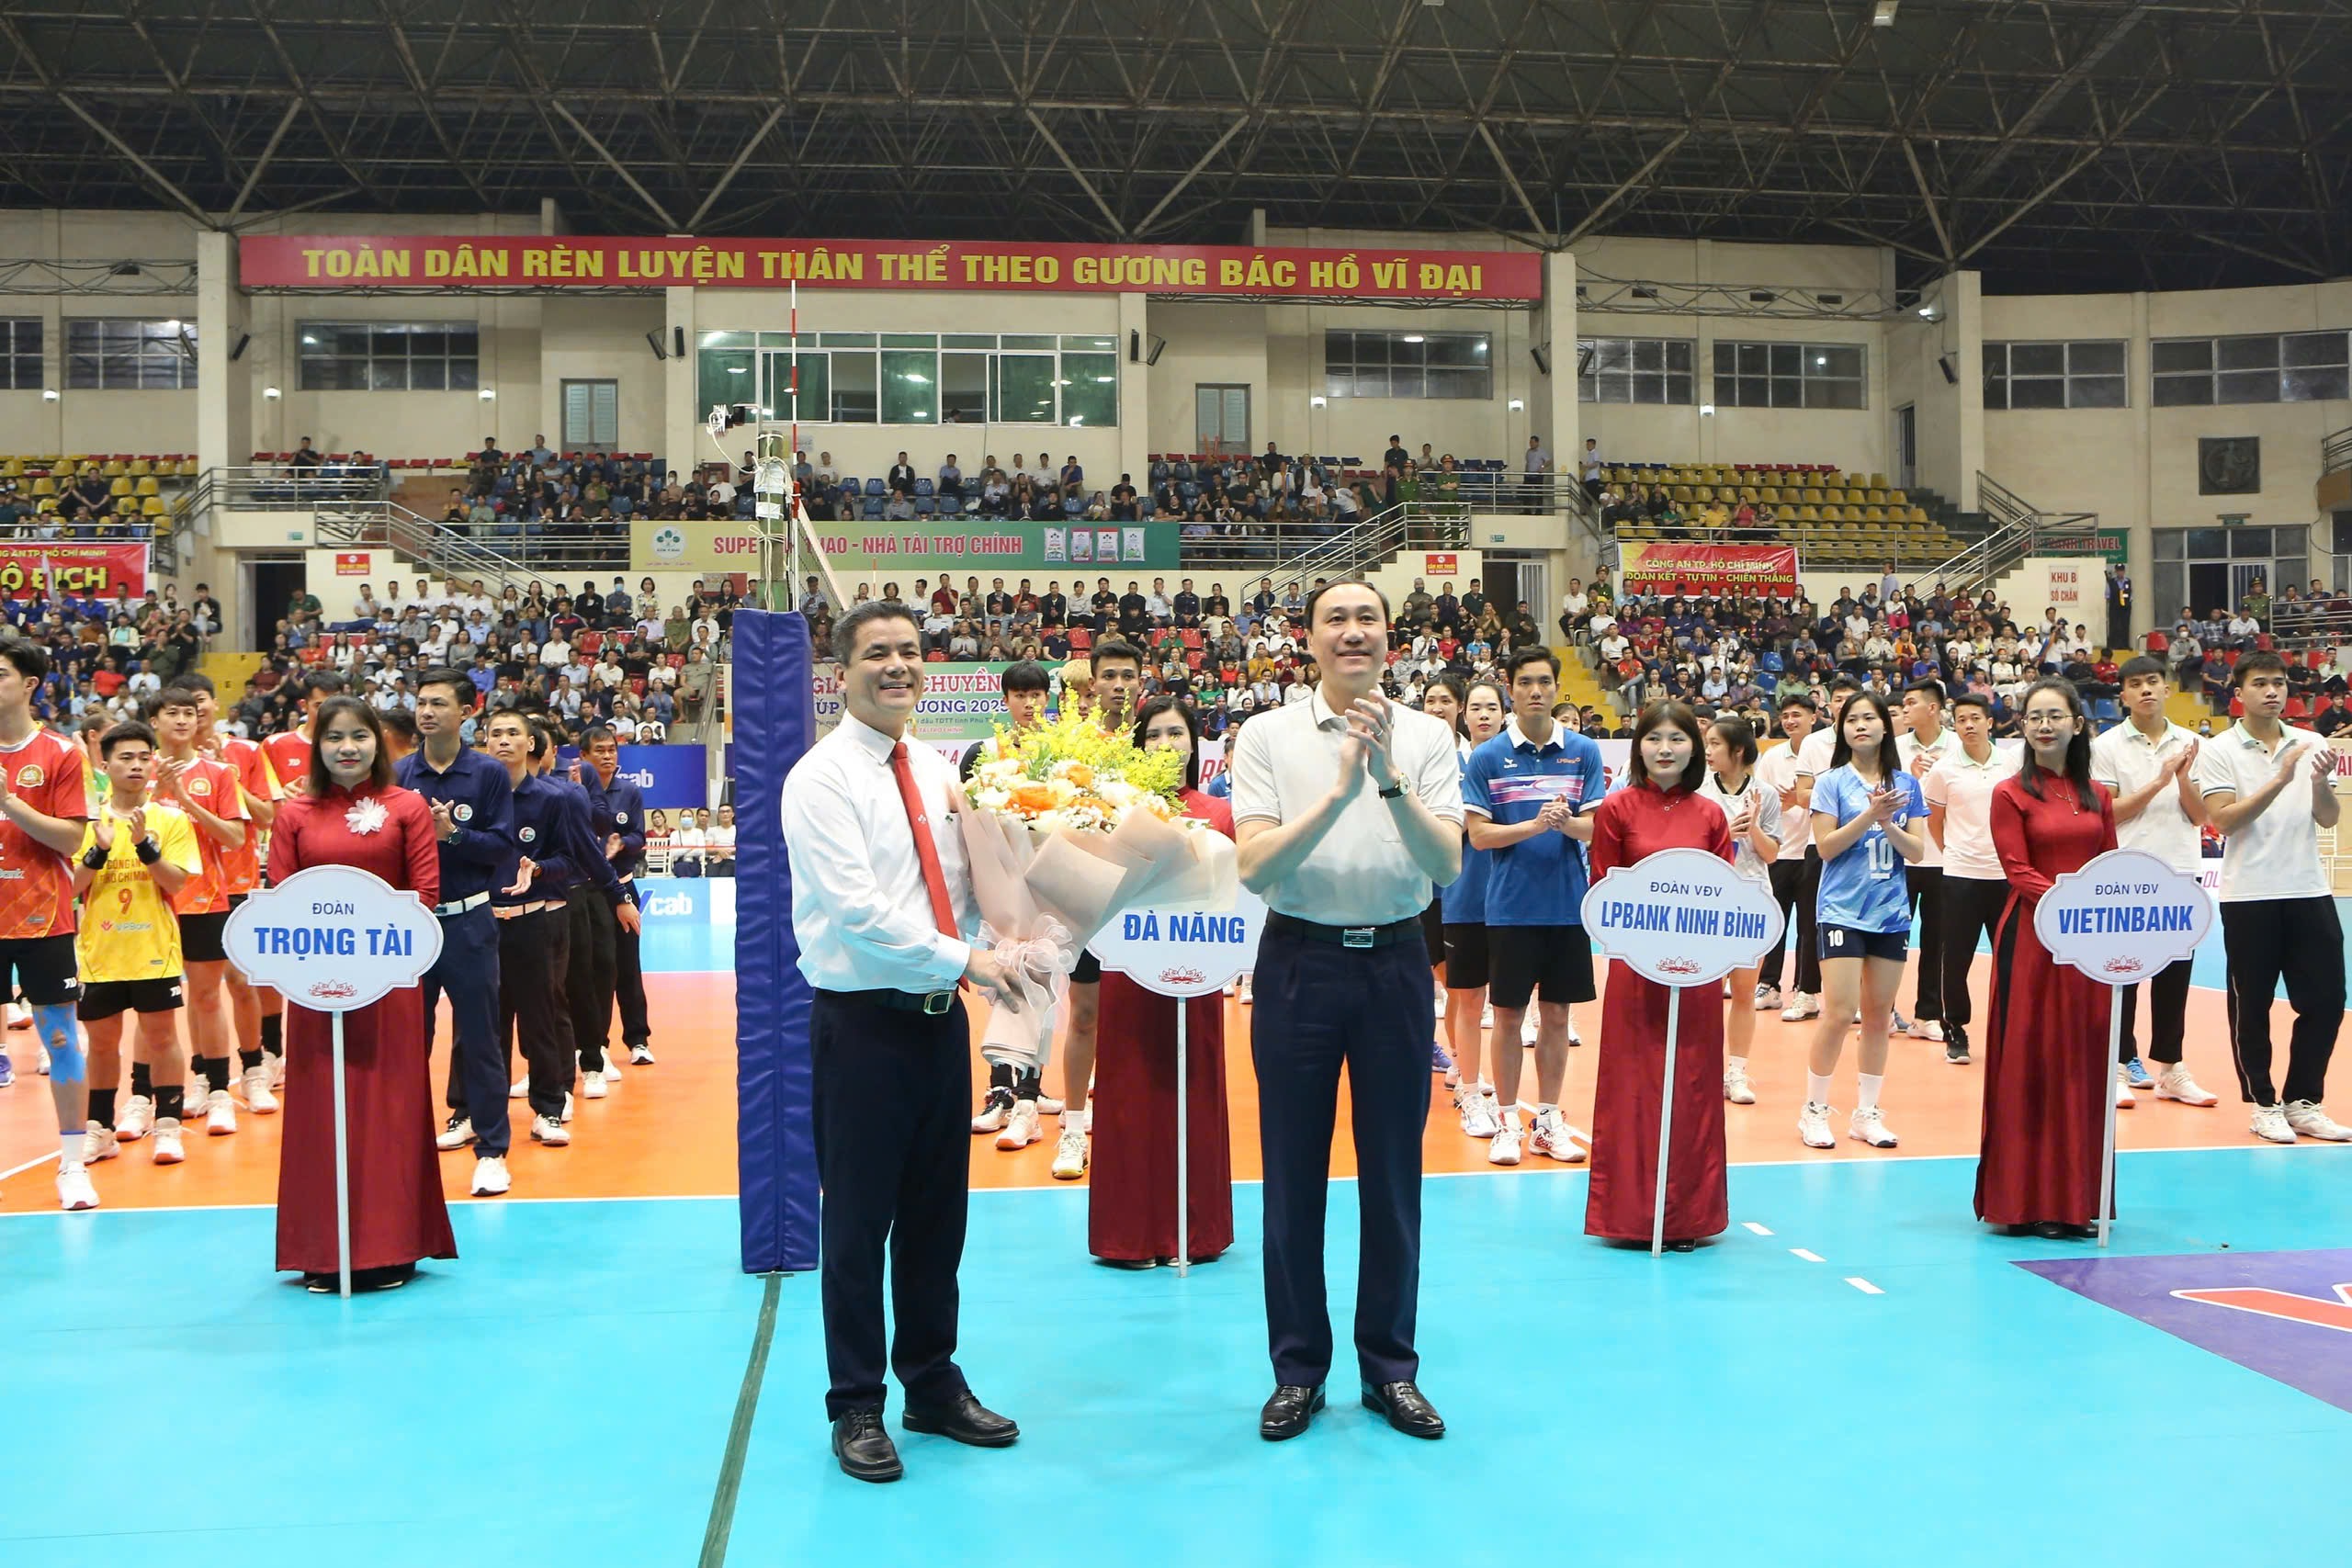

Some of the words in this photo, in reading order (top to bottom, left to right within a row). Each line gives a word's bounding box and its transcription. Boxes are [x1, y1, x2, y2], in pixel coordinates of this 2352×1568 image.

[302, 243, 411, 277] TOÀN
[424, 243, 516, 277] DÂN
[524, 244, 604, 277] RÈN
[617, 245, 745, 284] LUYỆN
[758, 246, 864, 279] THÂN
[876, 244, 950, 281] THỂ
[962, 255, 1059, 283] THEO
[1072, 254, 1207, 286] GƯƠNG
[1220, 254, 1297, 288] BÁC
[1310, 254, 1360, 288] HỒ
[1373, 258, 1408, 289] VĨ
[1419, 265, 1483, 297] ĐẠI
[714, 536, 758, 554] SUPE
[863, 534, 896, 554] NHÀ
[902, 535, 929, 554] TÀI
[933, 536, 965, 557] TRỢ
[970, 533, 1023, 554] CHÍNH
[1677, 559, 1691, 569] AN
[0, 561, 24, 591] Ô
[1702, 573, 1718, 581] TIN
[2051, 572, 2069, 583] KHU
[2071, 572, 2077, 582] B
[816, 698, 840, 715] ÚP
[915, 700, 966, 713] ƯƠNG
[971, 700, 1009, 712] 2025
[616, 766, 654, 788] cab
[1865, 838, 1894, 870] 10
[1650, 881, 1690, 895] ĐOÀN
[1694, 885, 1723, 897] VĐV
[2096, 883, 2130, 896] ĐOÀN
[2133, 884, 2159, 895] VĐV
[119, 888, 132, 915] 9
[312, 900, 355, 915] ĐOÀN
[1124, 910, 1159, 941] ĐÀ
[1170, 911, 1245, 943] NĂNG
[1600, 901, 1671, 932] LPBANK
[1675, 907, 1719, 936] NINH
[1724, 906, 1766, 940] BÌNH
[2058, 905, 2194, 934] VIETINBANK
[254, 928, 355, 961] TRỌNG
[366, 923, 413, 956] TÀI
[1828, 930, 1844, 947] 10
